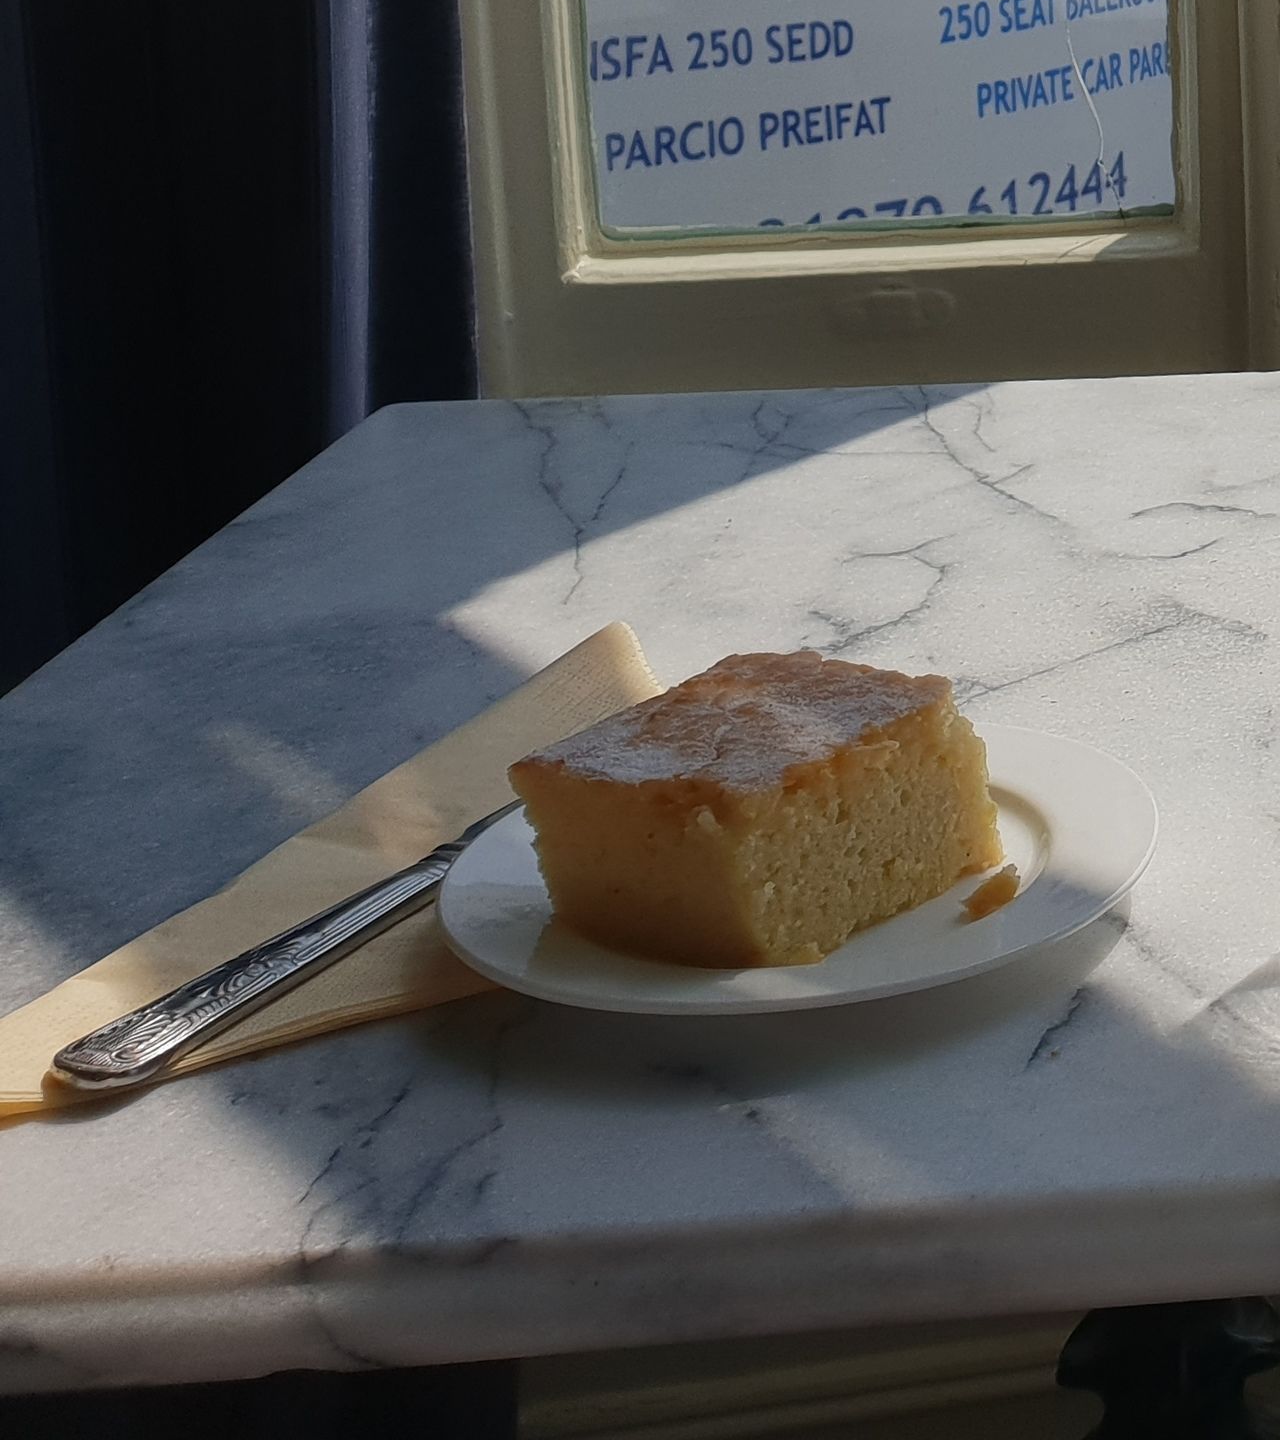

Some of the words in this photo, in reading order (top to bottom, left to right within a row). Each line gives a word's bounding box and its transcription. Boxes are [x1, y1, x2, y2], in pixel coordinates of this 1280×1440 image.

[686, 27, 753, 71] 250
[765, 20, 854, 65] SEDD
[940, 2, 990, 44] 250
[977, 63, 1073, 117] PRIVATE
[1082, 52, 1123, 95] CAR
[606, 116, 744, 172] PARCIO
[758, 96, 891, 151] PREIFAT
